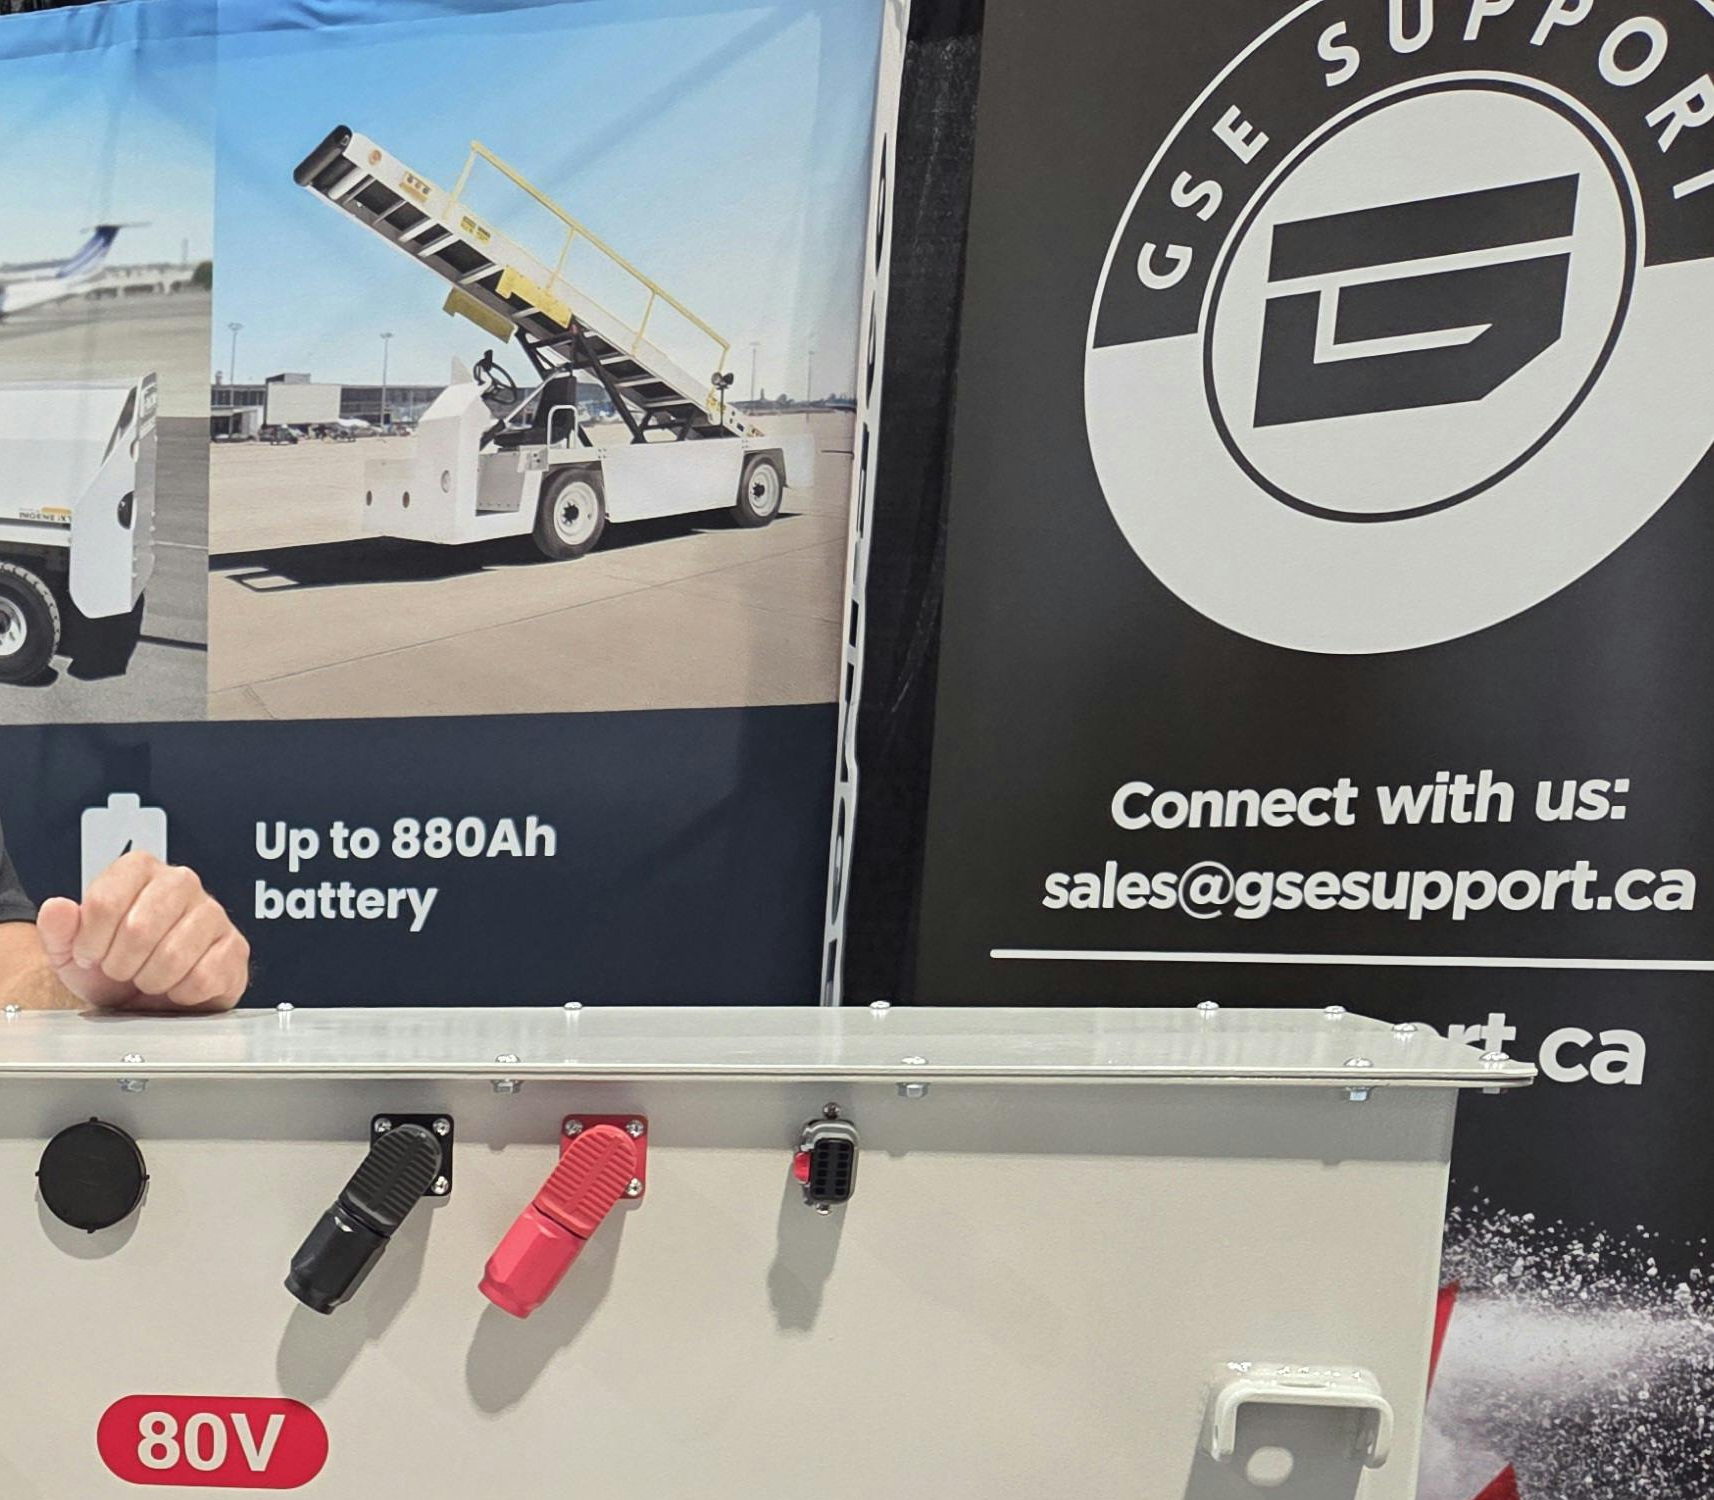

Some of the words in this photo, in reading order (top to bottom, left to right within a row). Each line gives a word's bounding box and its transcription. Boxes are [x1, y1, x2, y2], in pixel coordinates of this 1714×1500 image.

[1136, 105, 1270, 290] GSE
[1111, 778, 1358, 830] Connect
[1376, 769, 1515, 825] with
[1535, 778, 1631, 822] us:
[255, 821, 319, 873] Up
[330, 821, 380, 859] to
[391, 816, 557, 859] 880Ah
[254, 880, 439, 932] battery
[1042, 860, 1697, 921] sales@gsesupport.ca
[135, 1412, 286, 1472] 80V
